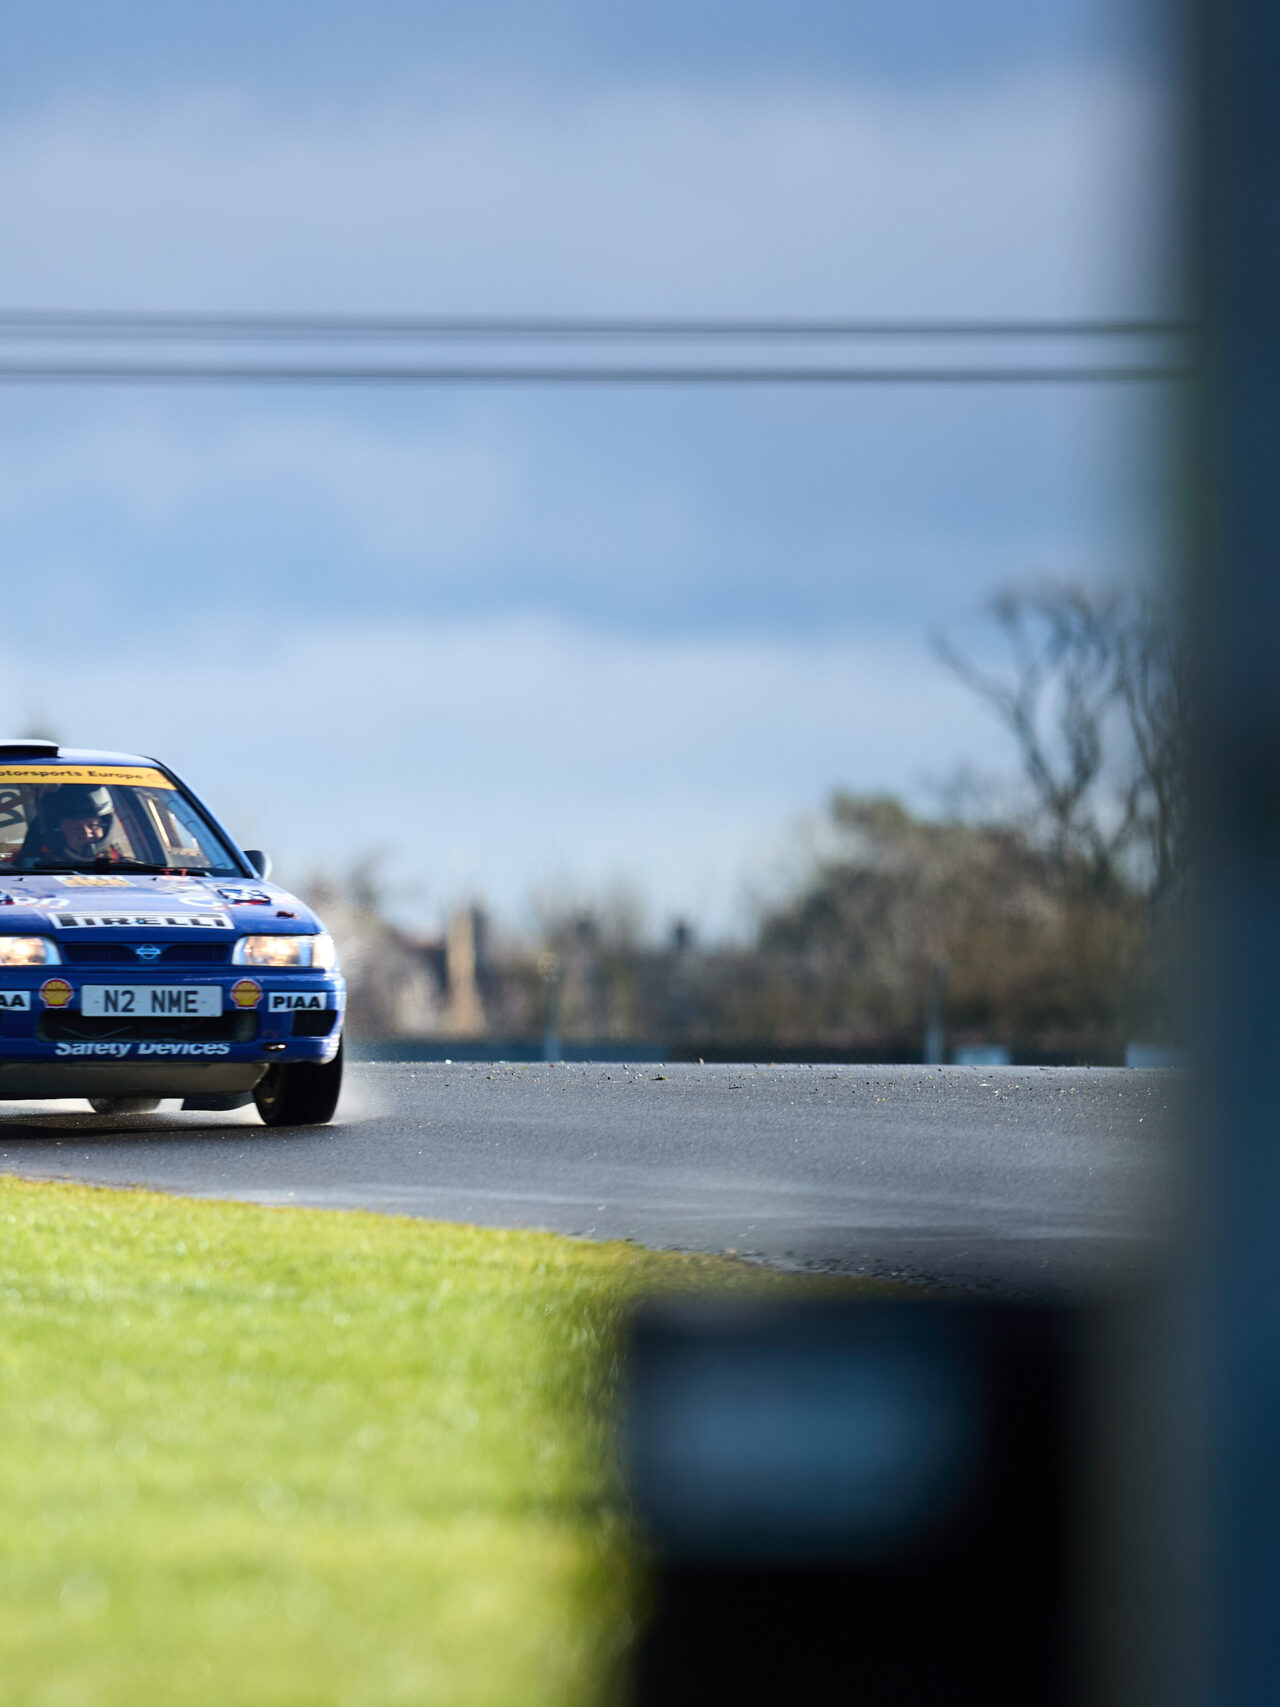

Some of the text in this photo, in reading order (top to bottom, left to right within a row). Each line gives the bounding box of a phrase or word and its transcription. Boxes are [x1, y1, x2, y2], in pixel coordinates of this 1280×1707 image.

[88, 769, 144, 781] Europe
[55, 913, 227, 928] PIRELLI
[104, 990, 199, 1013] N2 NME
[273, 996, 321, 1009] PIAA
[54, 1042, 231, 1058] Safety Devices
